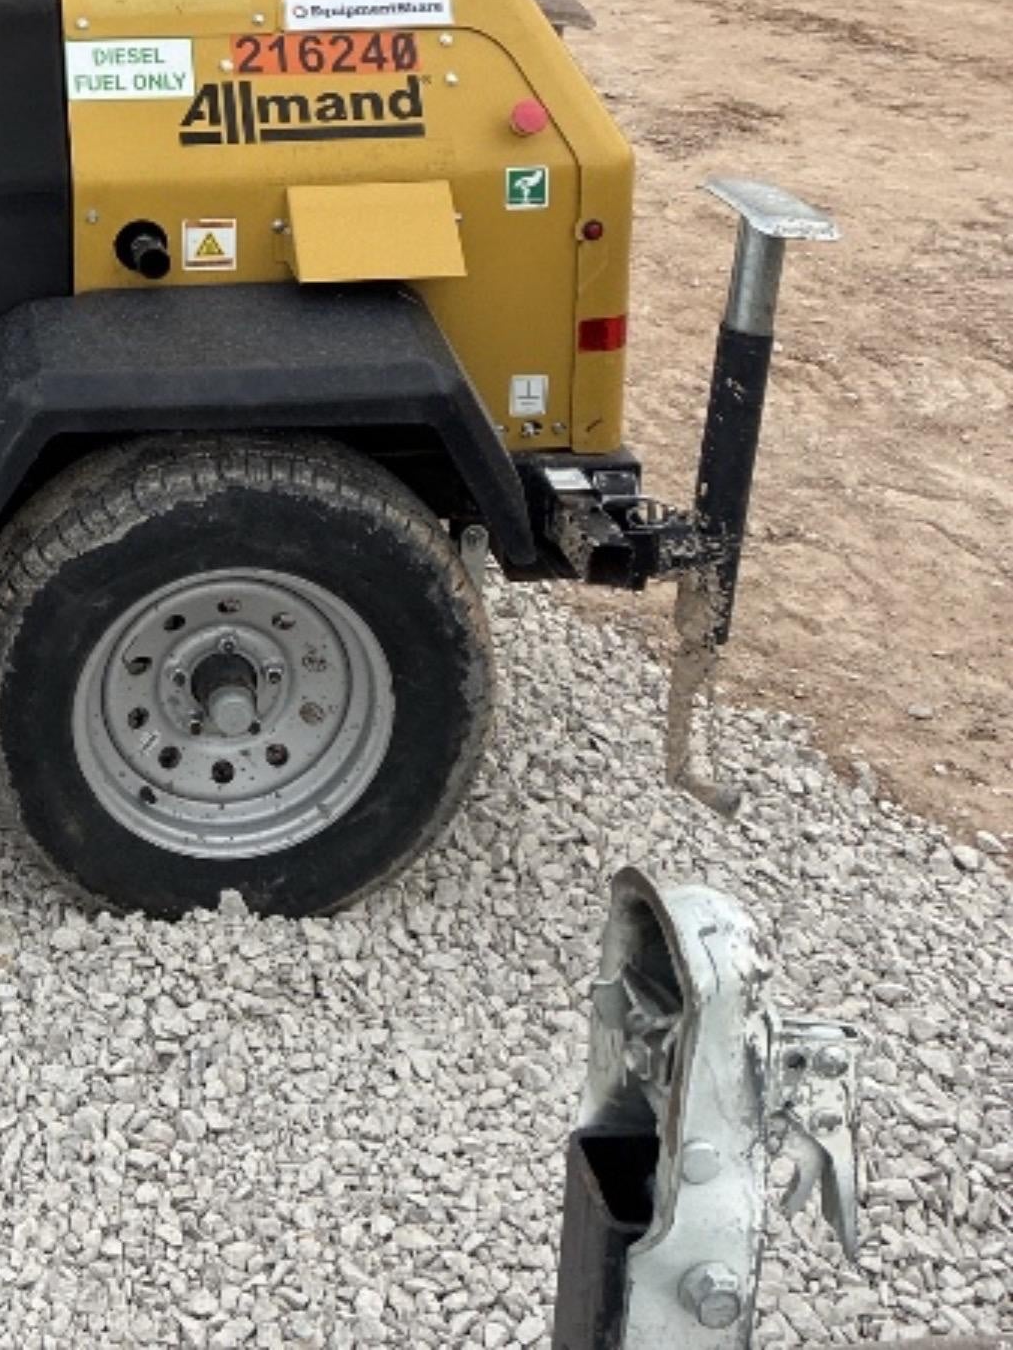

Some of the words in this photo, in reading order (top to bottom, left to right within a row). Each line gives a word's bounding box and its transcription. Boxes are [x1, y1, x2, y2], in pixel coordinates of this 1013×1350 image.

[92, 47, 165, 67] DIESEL
[235, 34, 418, 74] 216240
[74, 74, 126, 93] FUEL
[133, 71, 186, 91] ONLY
[180, 75, 424, 144] Allmand
